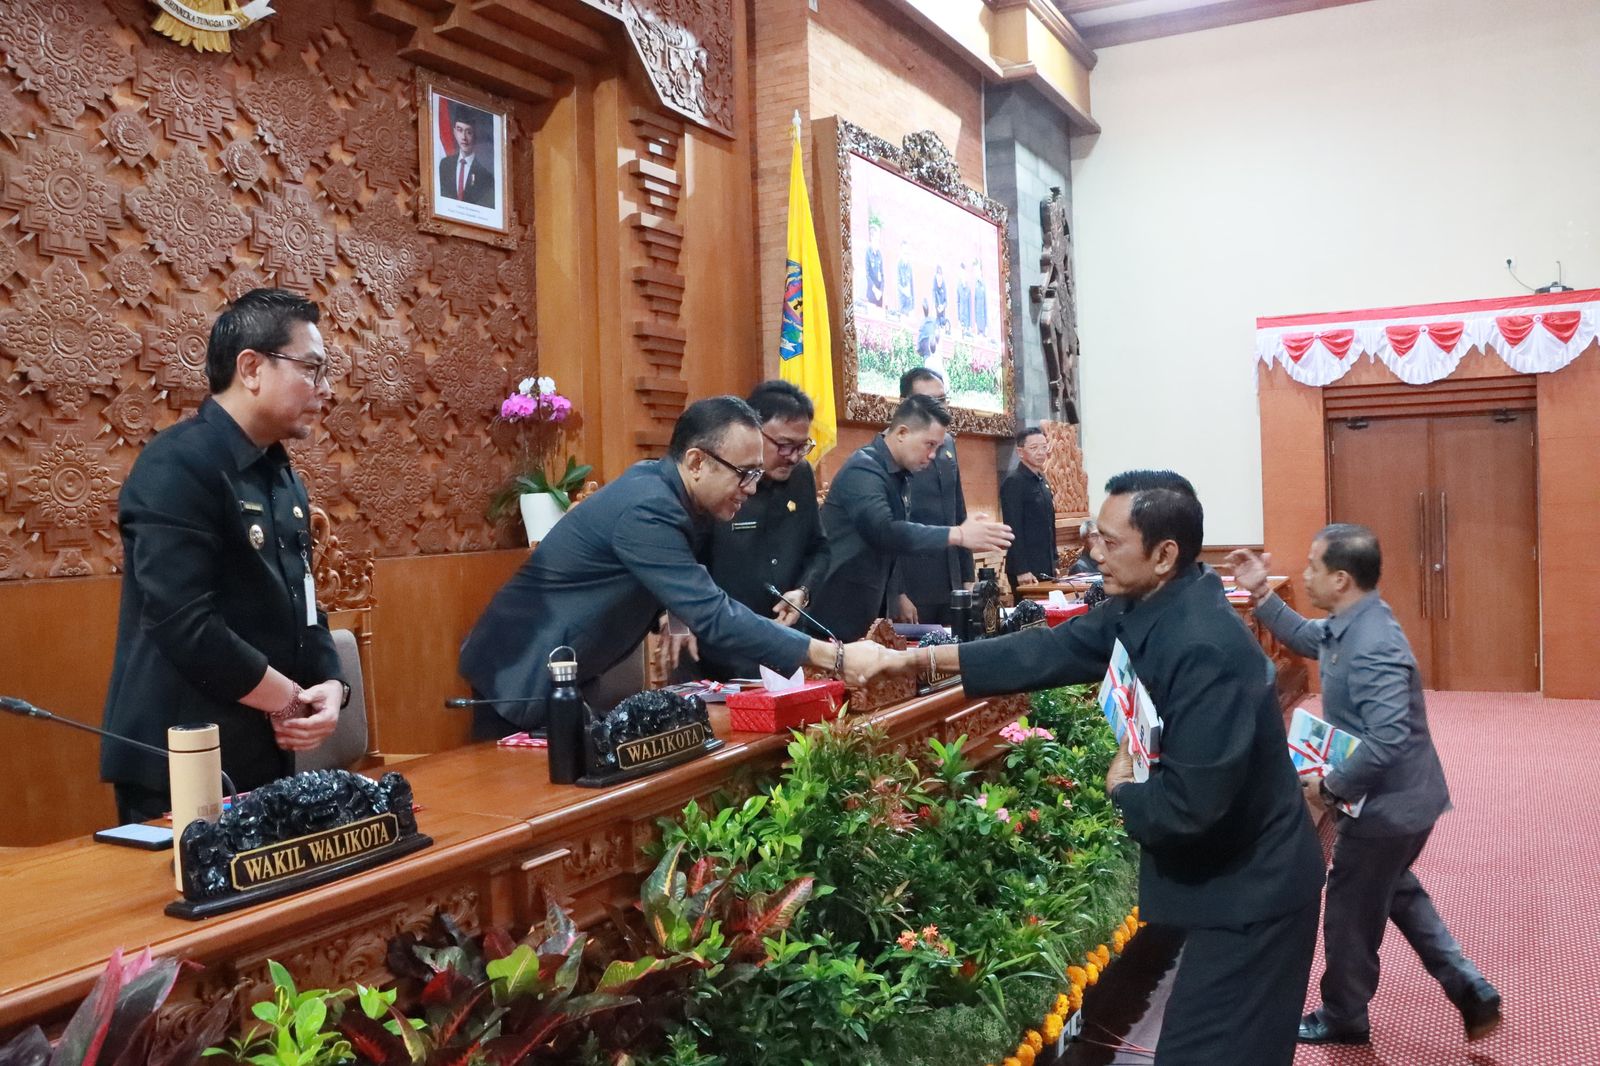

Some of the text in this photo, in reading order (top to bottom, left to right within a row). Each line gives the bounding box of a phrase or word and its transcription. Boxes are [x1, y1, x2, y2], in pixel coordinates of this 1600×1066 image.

[197, 17, 224, 28] TUNGGAL
[226, 18, 238, 27] IKA
[626, 728, 699, 763] WALIKOTA
[243, 822, 390, 882] WAKIL WALIKOTA
